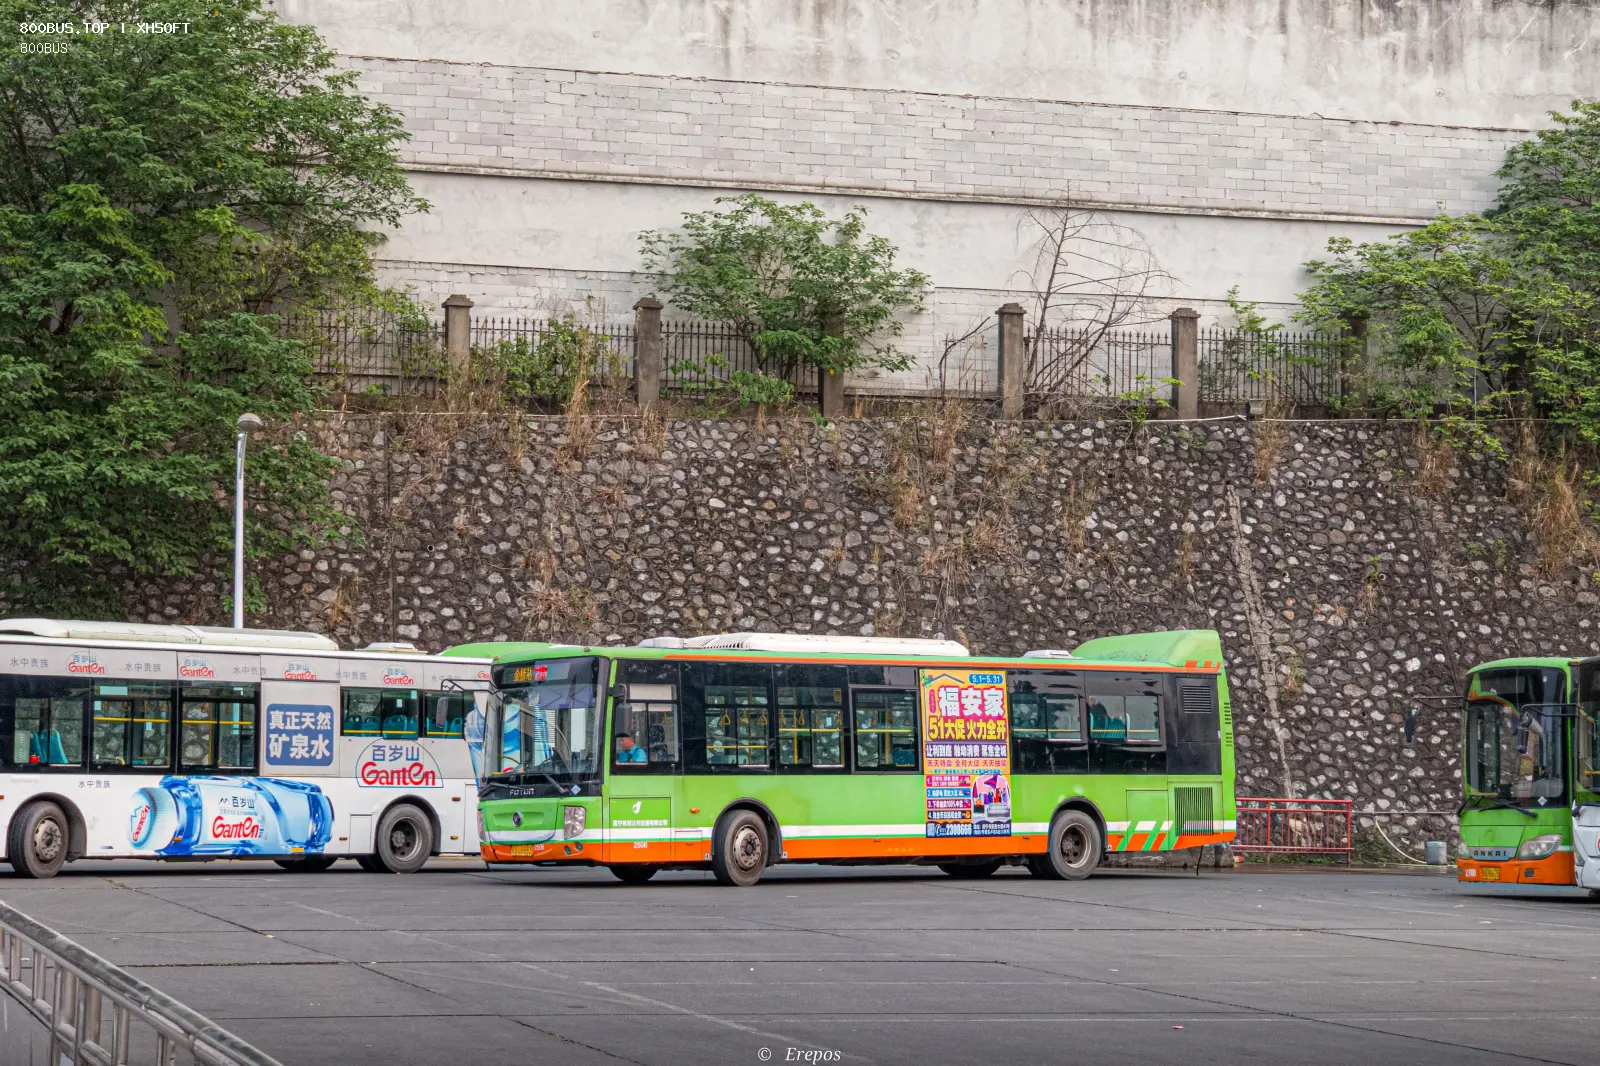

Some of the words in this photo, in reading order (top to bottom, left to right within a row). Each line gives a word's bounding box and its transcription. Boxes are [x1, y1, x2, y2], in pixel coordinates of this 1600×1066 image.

[10, 657, 49, 668] 水中贵族
[73, 655, 97, 663] 百岁山
[184, 659, 207, 667] 百岁山
[68, 662, 105, 674] Ganten
[125, 662, 162, 673] 水中贵族
[179, 665, 215, 677] Ganten
[232, 666, 268, 676] 水中贵族
[335, 670, 368, 681] 水中贵族
[383, 674, 414, 686] Ganten
[972, 674, 1000, 683] 5.1-5.31
[938, 686, 1005, 717] 福安家
[269, 710, 332, 730] 真正天然
[966, 718, 1006, 740] 火力全开
[268, 733, 331, 760] 矿泉水
[372, 744, 420, 762] 百岁山
[361, 761, 436, 786] Ganten
[78, 780, 111, 789] 水中贵族
[232, 796, 255, 809] 百岁山
[212, 815, 260, 839] Ganten
